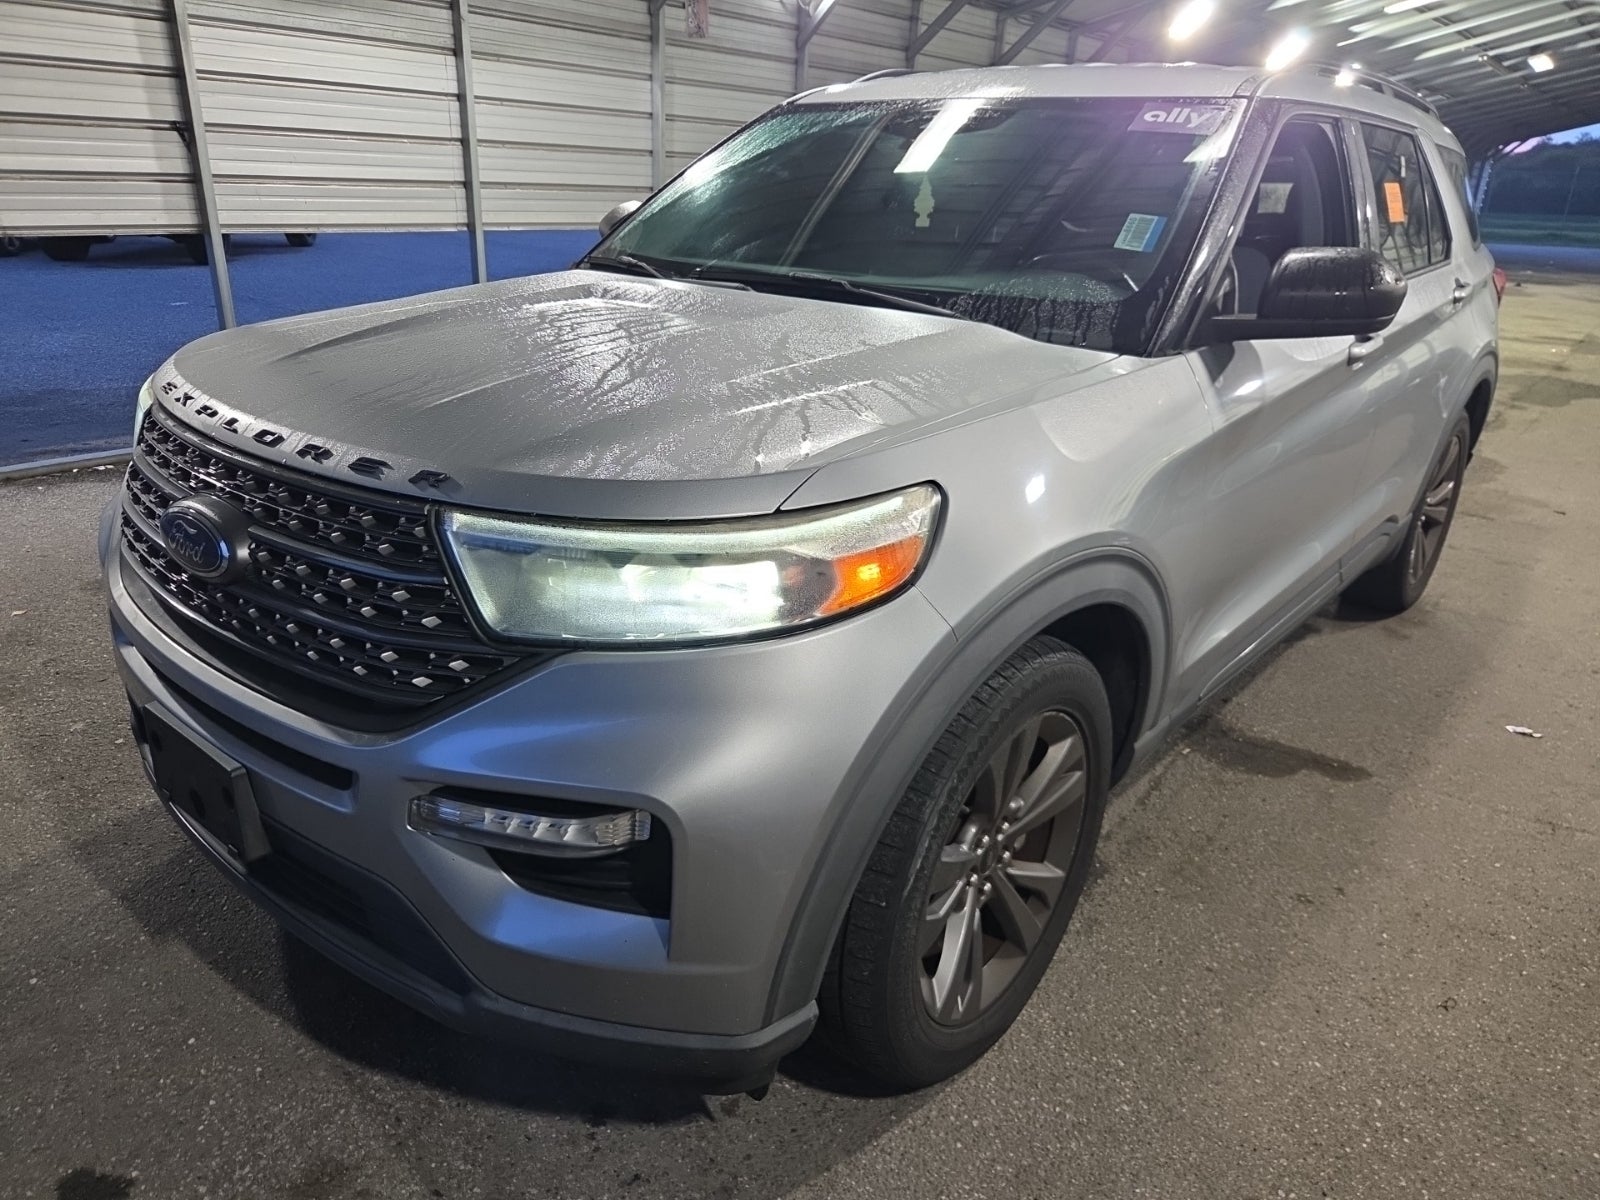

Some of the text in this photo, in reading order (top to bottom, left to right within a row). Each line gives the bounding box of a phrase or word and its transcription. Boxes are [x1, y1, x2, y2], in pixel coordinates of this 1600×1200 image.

[1143, 107, 1217, 128] ally
[161, 381, 450, 488] EXPLORER
[168, 520, 206, 563] Ford
